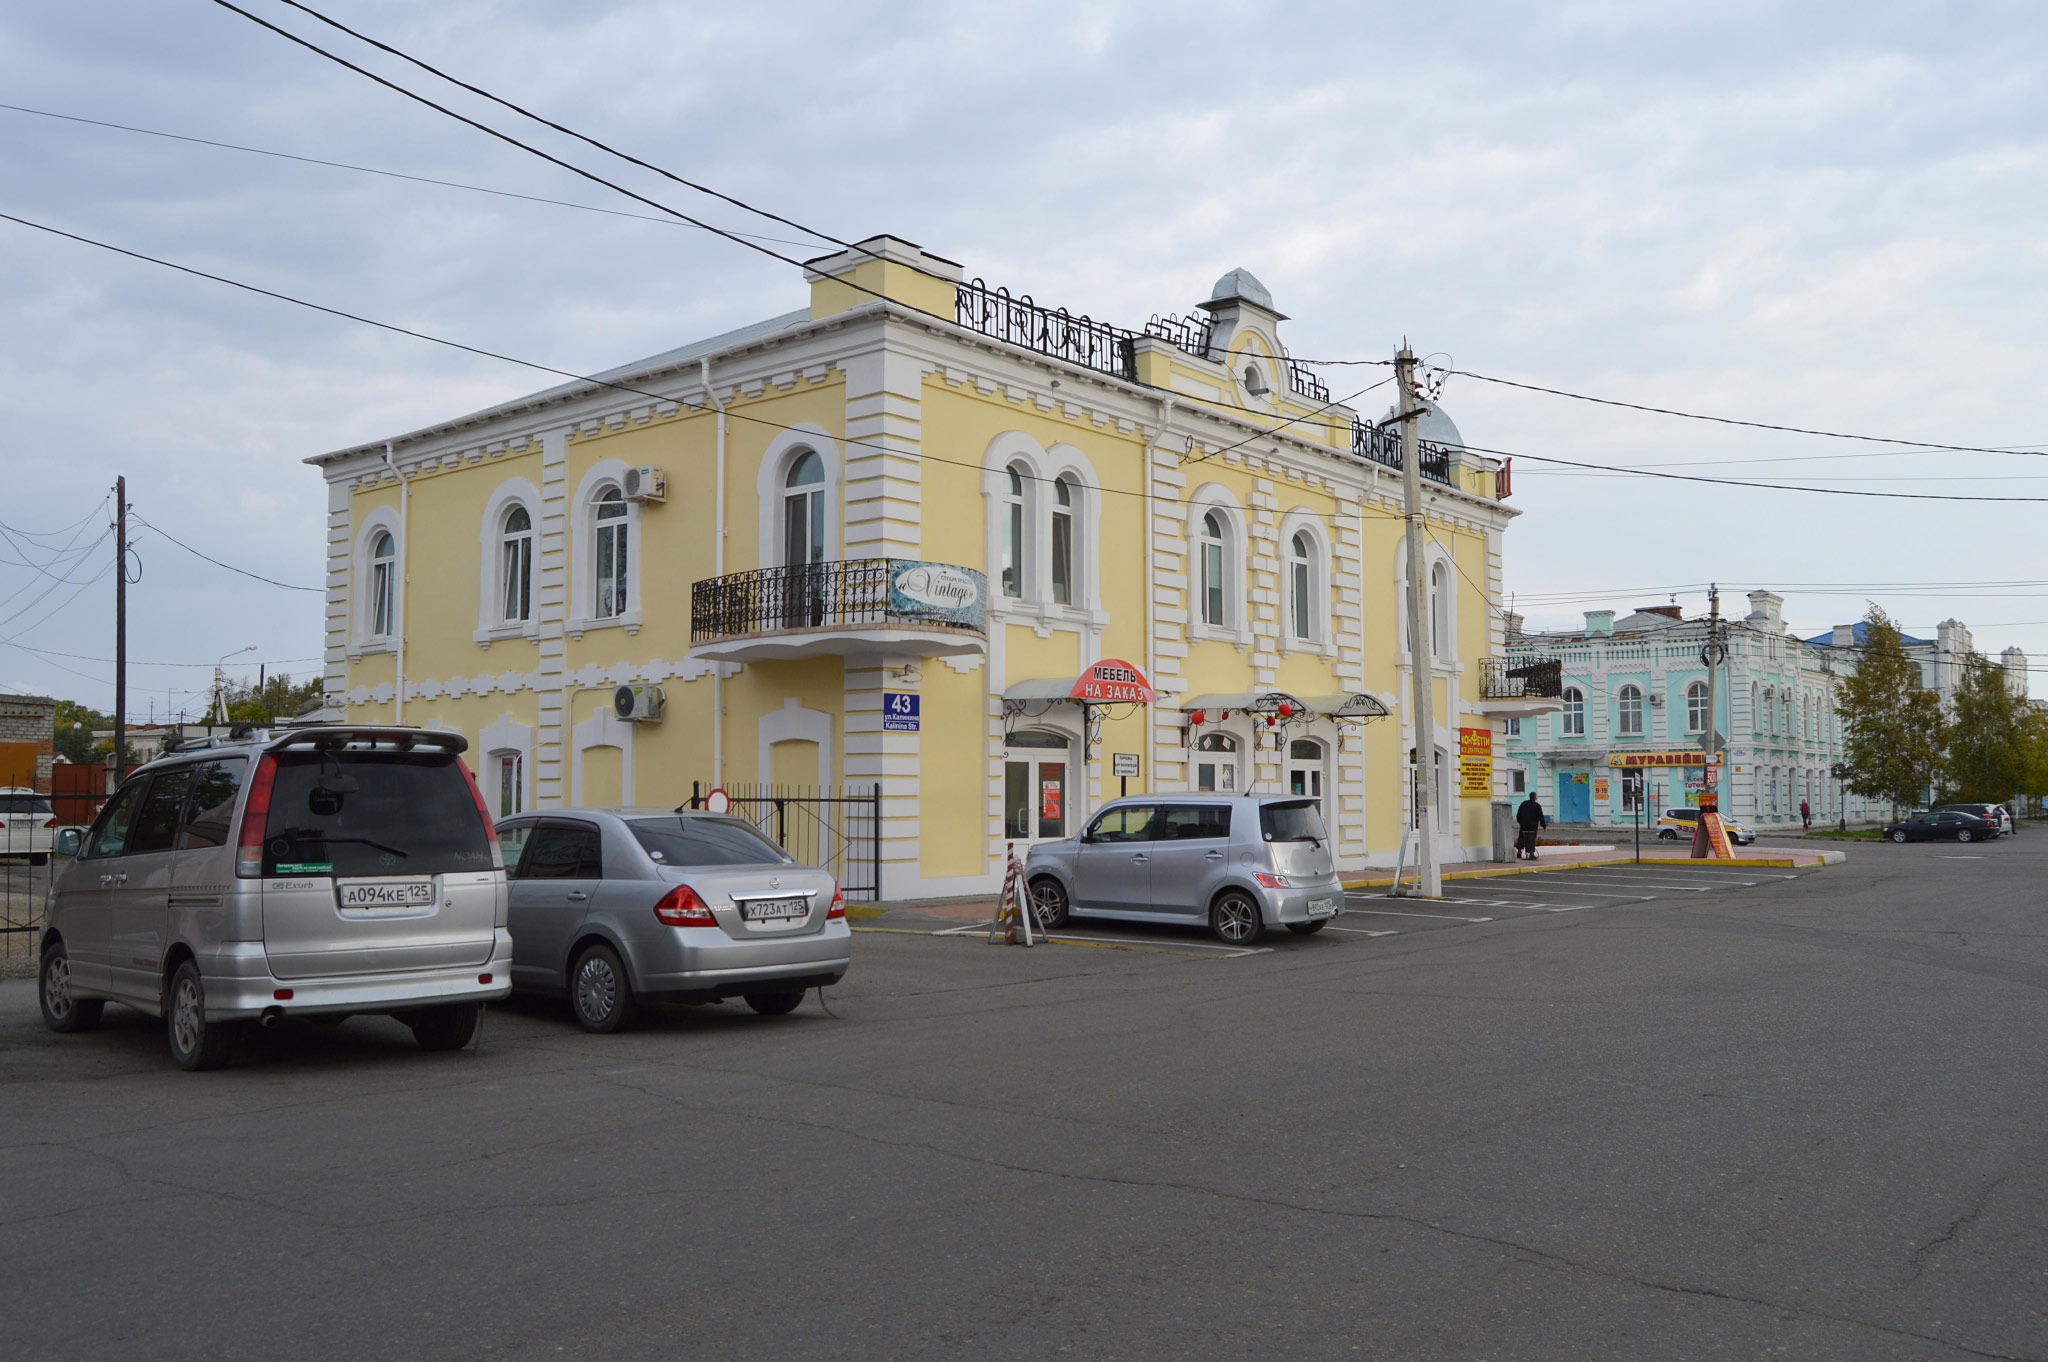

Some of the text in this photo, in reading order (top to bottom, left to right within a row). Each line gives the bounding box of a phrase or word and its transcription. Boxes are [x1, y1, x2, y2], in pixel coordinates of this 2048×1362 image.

[1093, 667, 1136, 683] МЕБЕЛЬ
[1085, 683, 1144, 700] НА ЗАКАЗ
[891, 694, 911, 713] 43
[885, 722, 907, 730] Kalinina
[1461, 730, 1490, 746] КОНФЕТТИ
[1626, 754, 1722, 765] МУРАВЕЙНК
[407, 885, 428, 897] 125
[789, 901, 804, 911] 125
